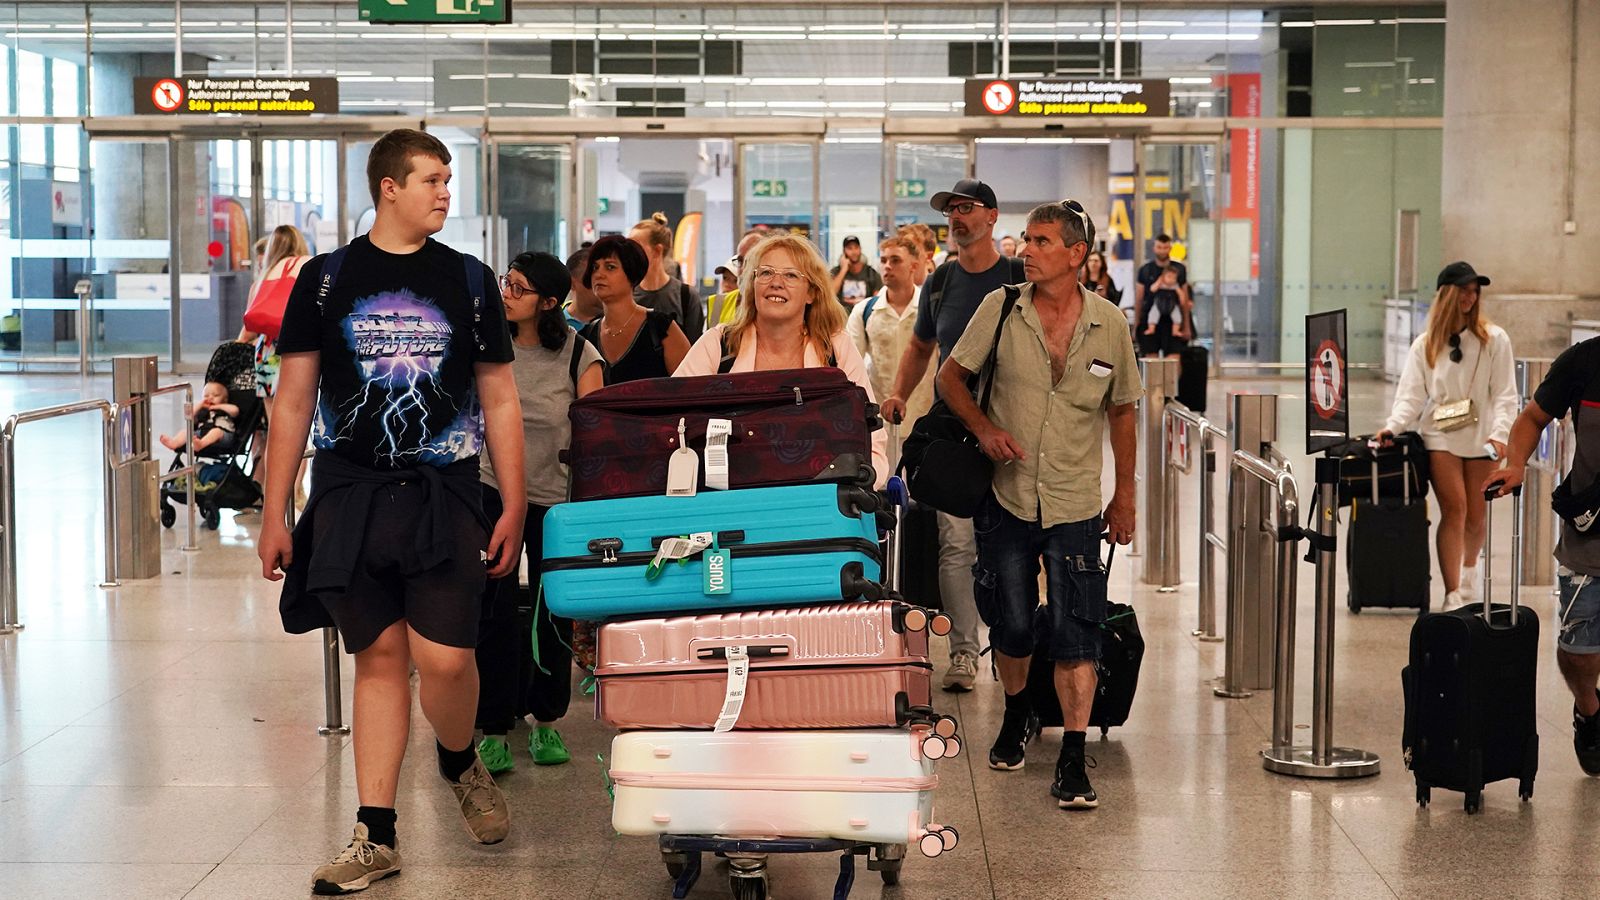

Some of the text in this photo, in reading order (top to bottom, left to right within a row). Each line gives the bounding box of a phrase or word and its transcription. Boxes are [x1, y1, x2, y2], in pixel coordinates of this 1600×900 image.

[188, 79, 310, 91] Nur Personal mit Genehmigung
[1019, 81, 1143, 94] Nur Personal mit Genehmigung
[188, 89, 291, 101] Authorized personnel only
[1019, 92, 1123, 104] Authorized personnel only
[188, 99, 315, 112] Sólo personal autorizado
[1044, 101, 1090, 116] personal
[1091, 101, 1147, 113] autorizado
[1109, 198, 1192, 240] ATM
[370, 336, 451, 355] FUTURE
[709, 555, 724, 592] YOURS
